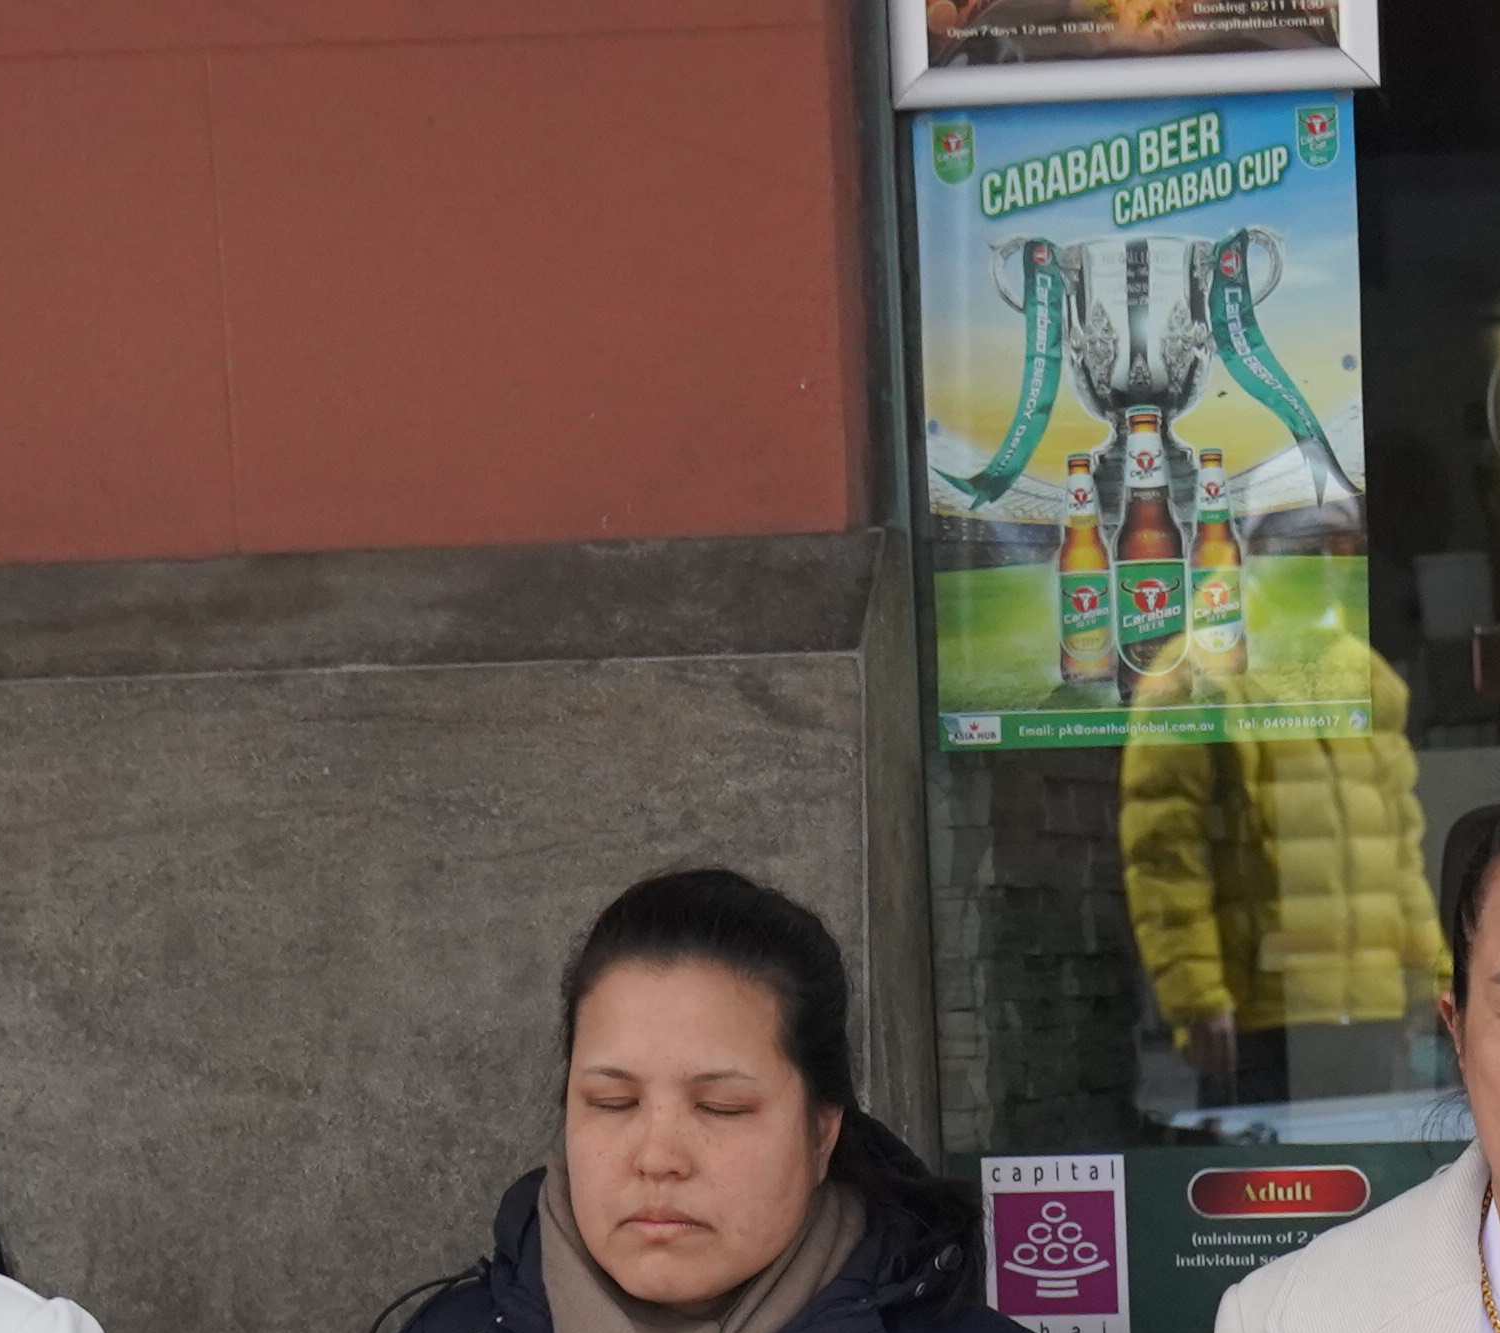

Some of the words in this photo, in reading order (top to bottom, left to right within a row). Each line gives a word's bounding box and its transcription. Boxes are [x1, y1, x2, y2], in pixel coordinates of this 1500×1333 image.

[946, 26, 979, 39] Open
[981, 25, 988, 38] 7
[991, 25, 1018, 39] days
[1022, 23, 1036, 35] 12
[1038, 26, 1057, 38] pm
[1096, 20, 1116, 34] pm
[982, 136, 1131, 216] CARABAO
[1138, 111, 1221, 174] BEER
[1113, 162, 1233, 225] CARABAO
[1237, 145, 1290, 191] CUP
[1022, 355, 1047, 421] ENERGY
[1122, 604, 1182, 628] Carabao
[1137, 619, 1166, 635] BEER
[1018, 724, 1054, 738] Email:
[1237, 718, 1260, 730] Tel:
[953, 732, 975, 742] ASIA
[977, 730, 998, 741] HUB
[992, 1160, 1115, 1186] capital
[1243, 1181, 1312, 1201] Adult
[1191, 1231, 1273, 1248] (minimum
[1276, 1231, 1293, 1244] of
[1297, 1231, 1308, 1244] 2
[1175, 1253, 1256, 1268] individual
